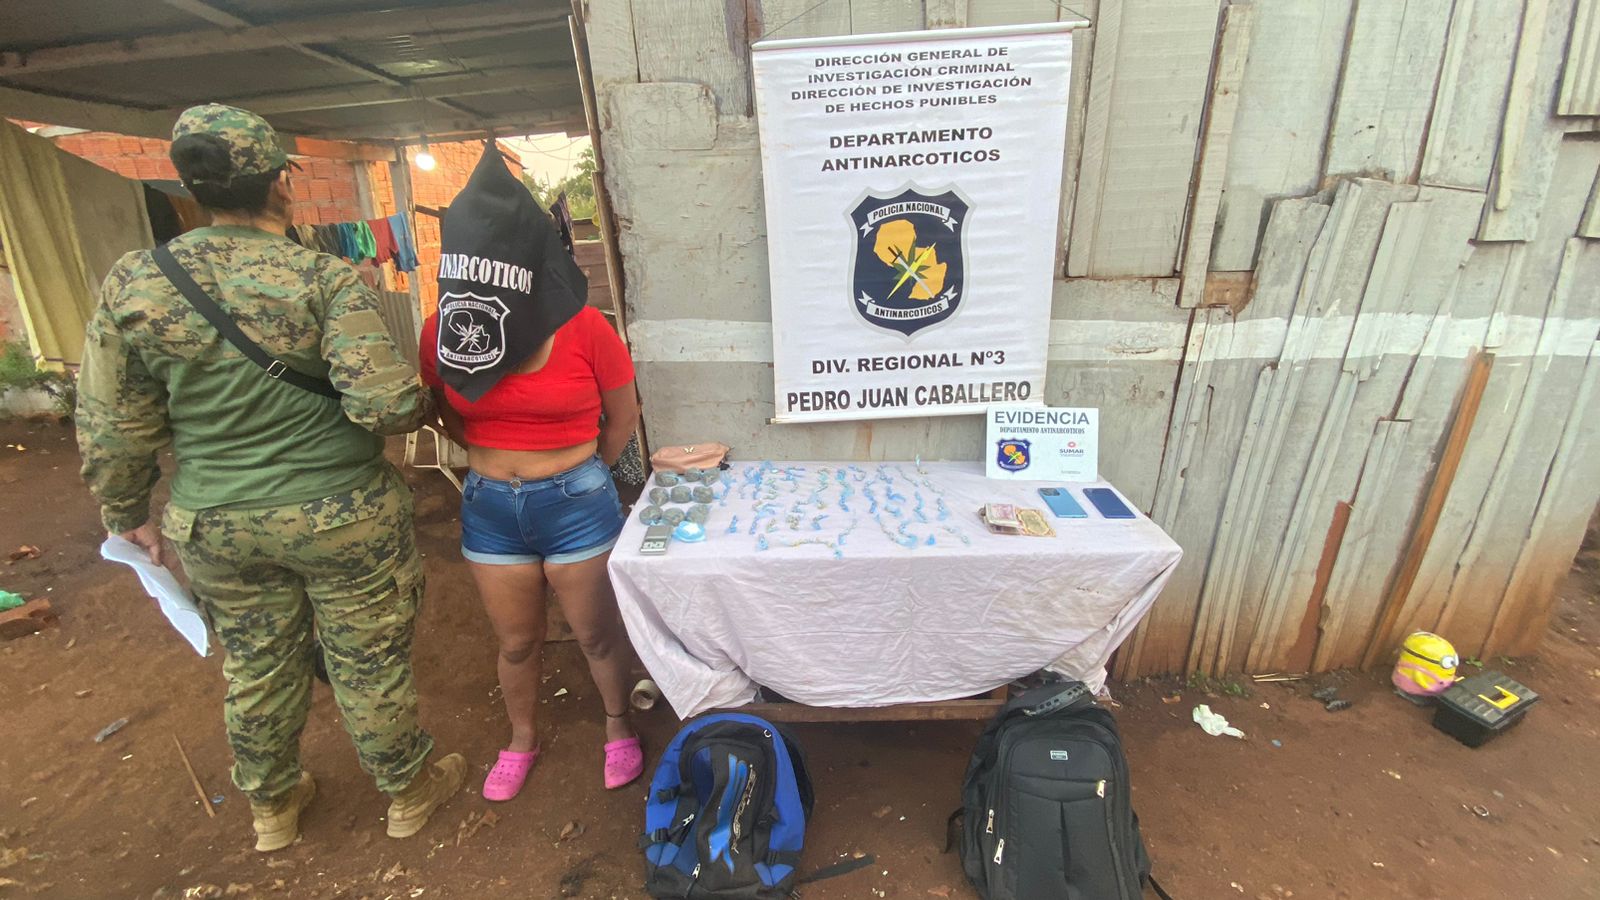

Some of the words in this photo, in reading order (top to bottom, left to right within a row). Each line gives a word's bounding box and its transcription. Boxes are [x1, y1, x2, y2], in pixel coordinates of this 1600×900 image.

[815, 52, 902, 67] DIRECCIÓN
[907, 48, 982, 61] GENERAL
[987, 46, 1009, 57] DE
[807, 66, 933, 84] INVESTIGACIÓN
[937, 62, 1015, 75] CRIMINAL
[791, 84, 876, 101] DIRECCIÓN
[881, 84, 903, 95] DE
[907, 76, 1032, 92] INVESTIGACIÓN
[825, 102, 846, 113] DE
[850, 99, 914, 112] HECHOS
[919, 94, 998, 107] PUNIBLES
[829, 126, 993, 149] DEPARTAMENTO
[821, 148, 1001, 172] ANTINARCOTICOS
[872, 205, 904, 220] POLICIA
[905, 202, 945, 217] NACIONAL
[874, 303, 943, 318] ANTINARCOTICOS
[812, 359, 850, 375] DIV.
[857, 352, 963, 373] REGIONAL
[787, 389, 851, 412] PEDRO
[856, 386, 909, 408] JUAN
[914, 380, 1032, 406] CABALLERO
[995, 411, 1090, 425] EVIDENCIA
